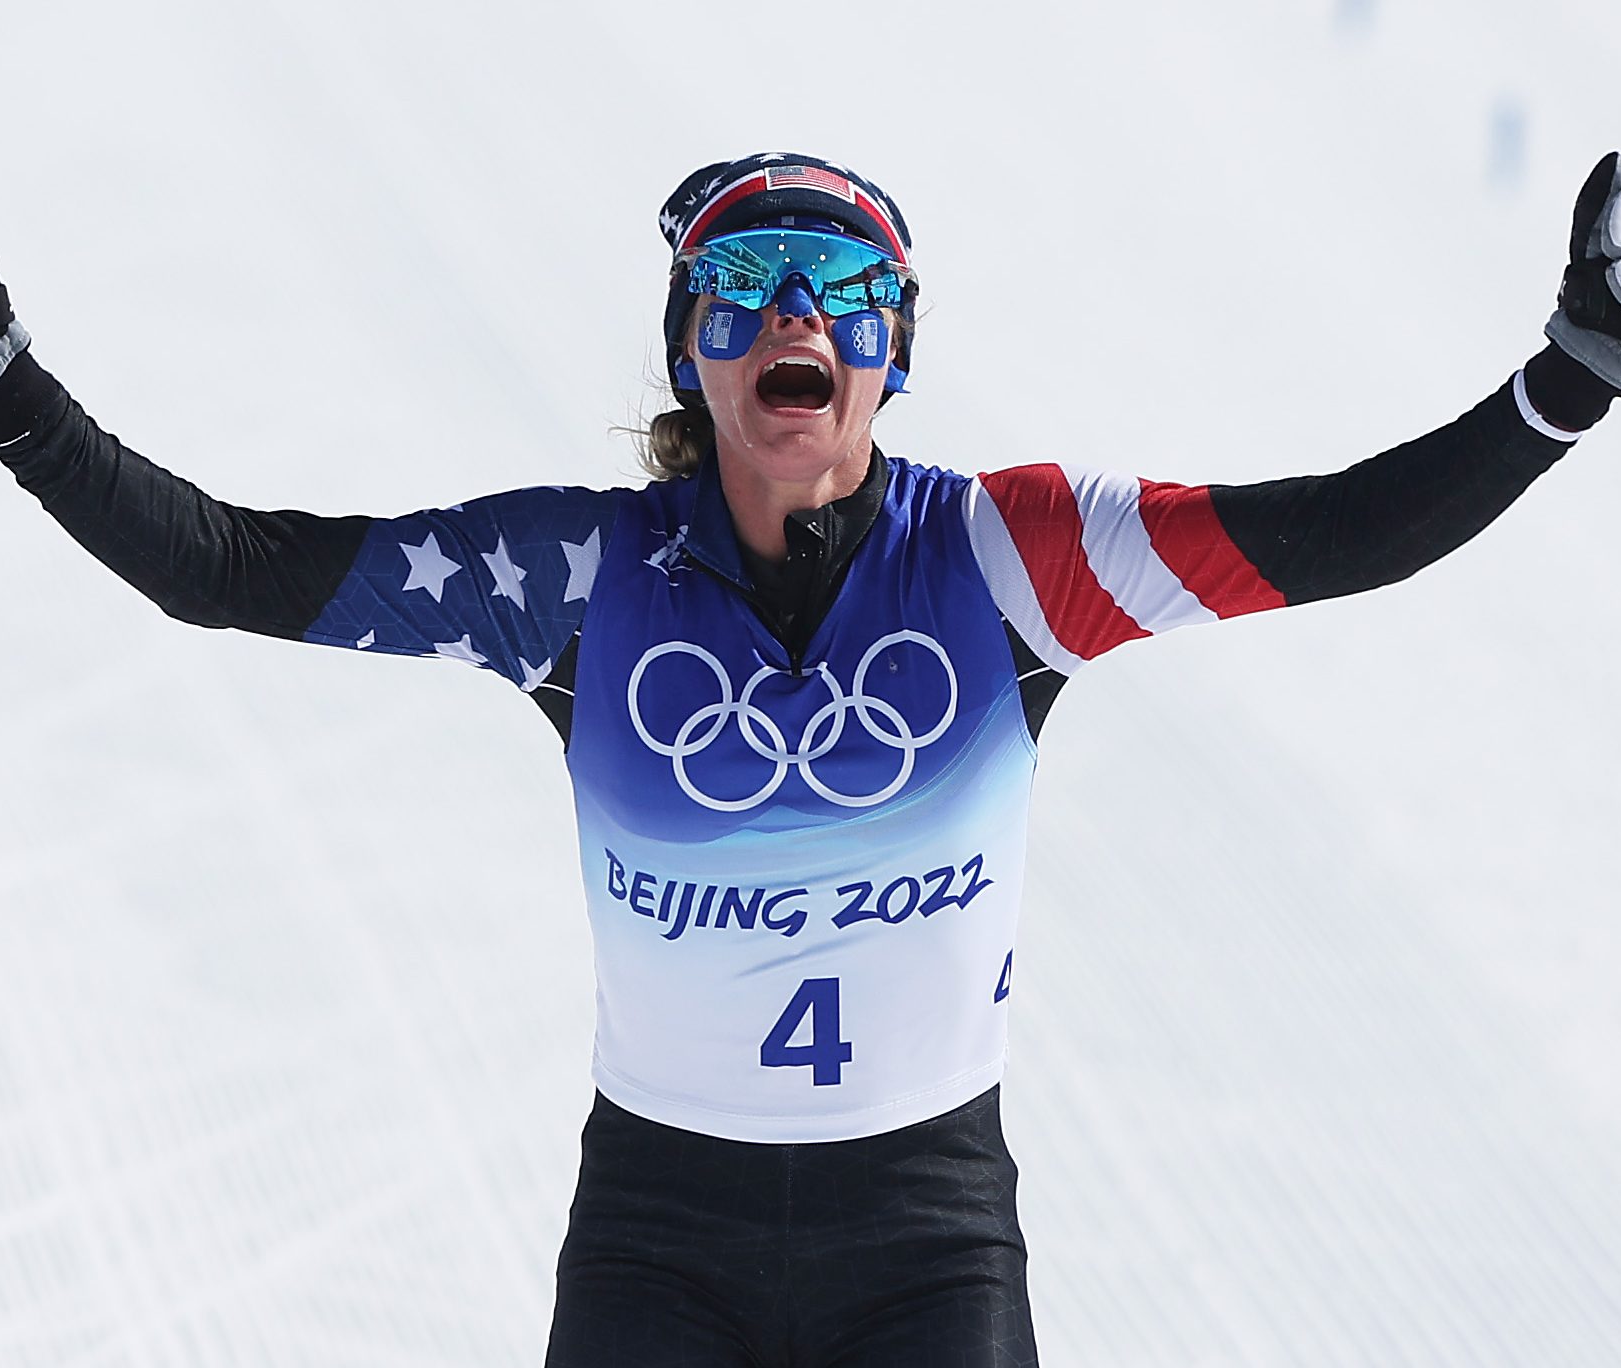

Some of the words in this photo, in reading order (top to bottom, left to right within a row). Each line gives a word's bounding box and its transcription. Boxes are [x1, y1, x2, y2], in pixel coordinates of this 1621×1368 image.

[604, 847, 809, 941] BEIJING
[830, 853, 994, 931] 2022
[760, 977, 853, 1086] 4
